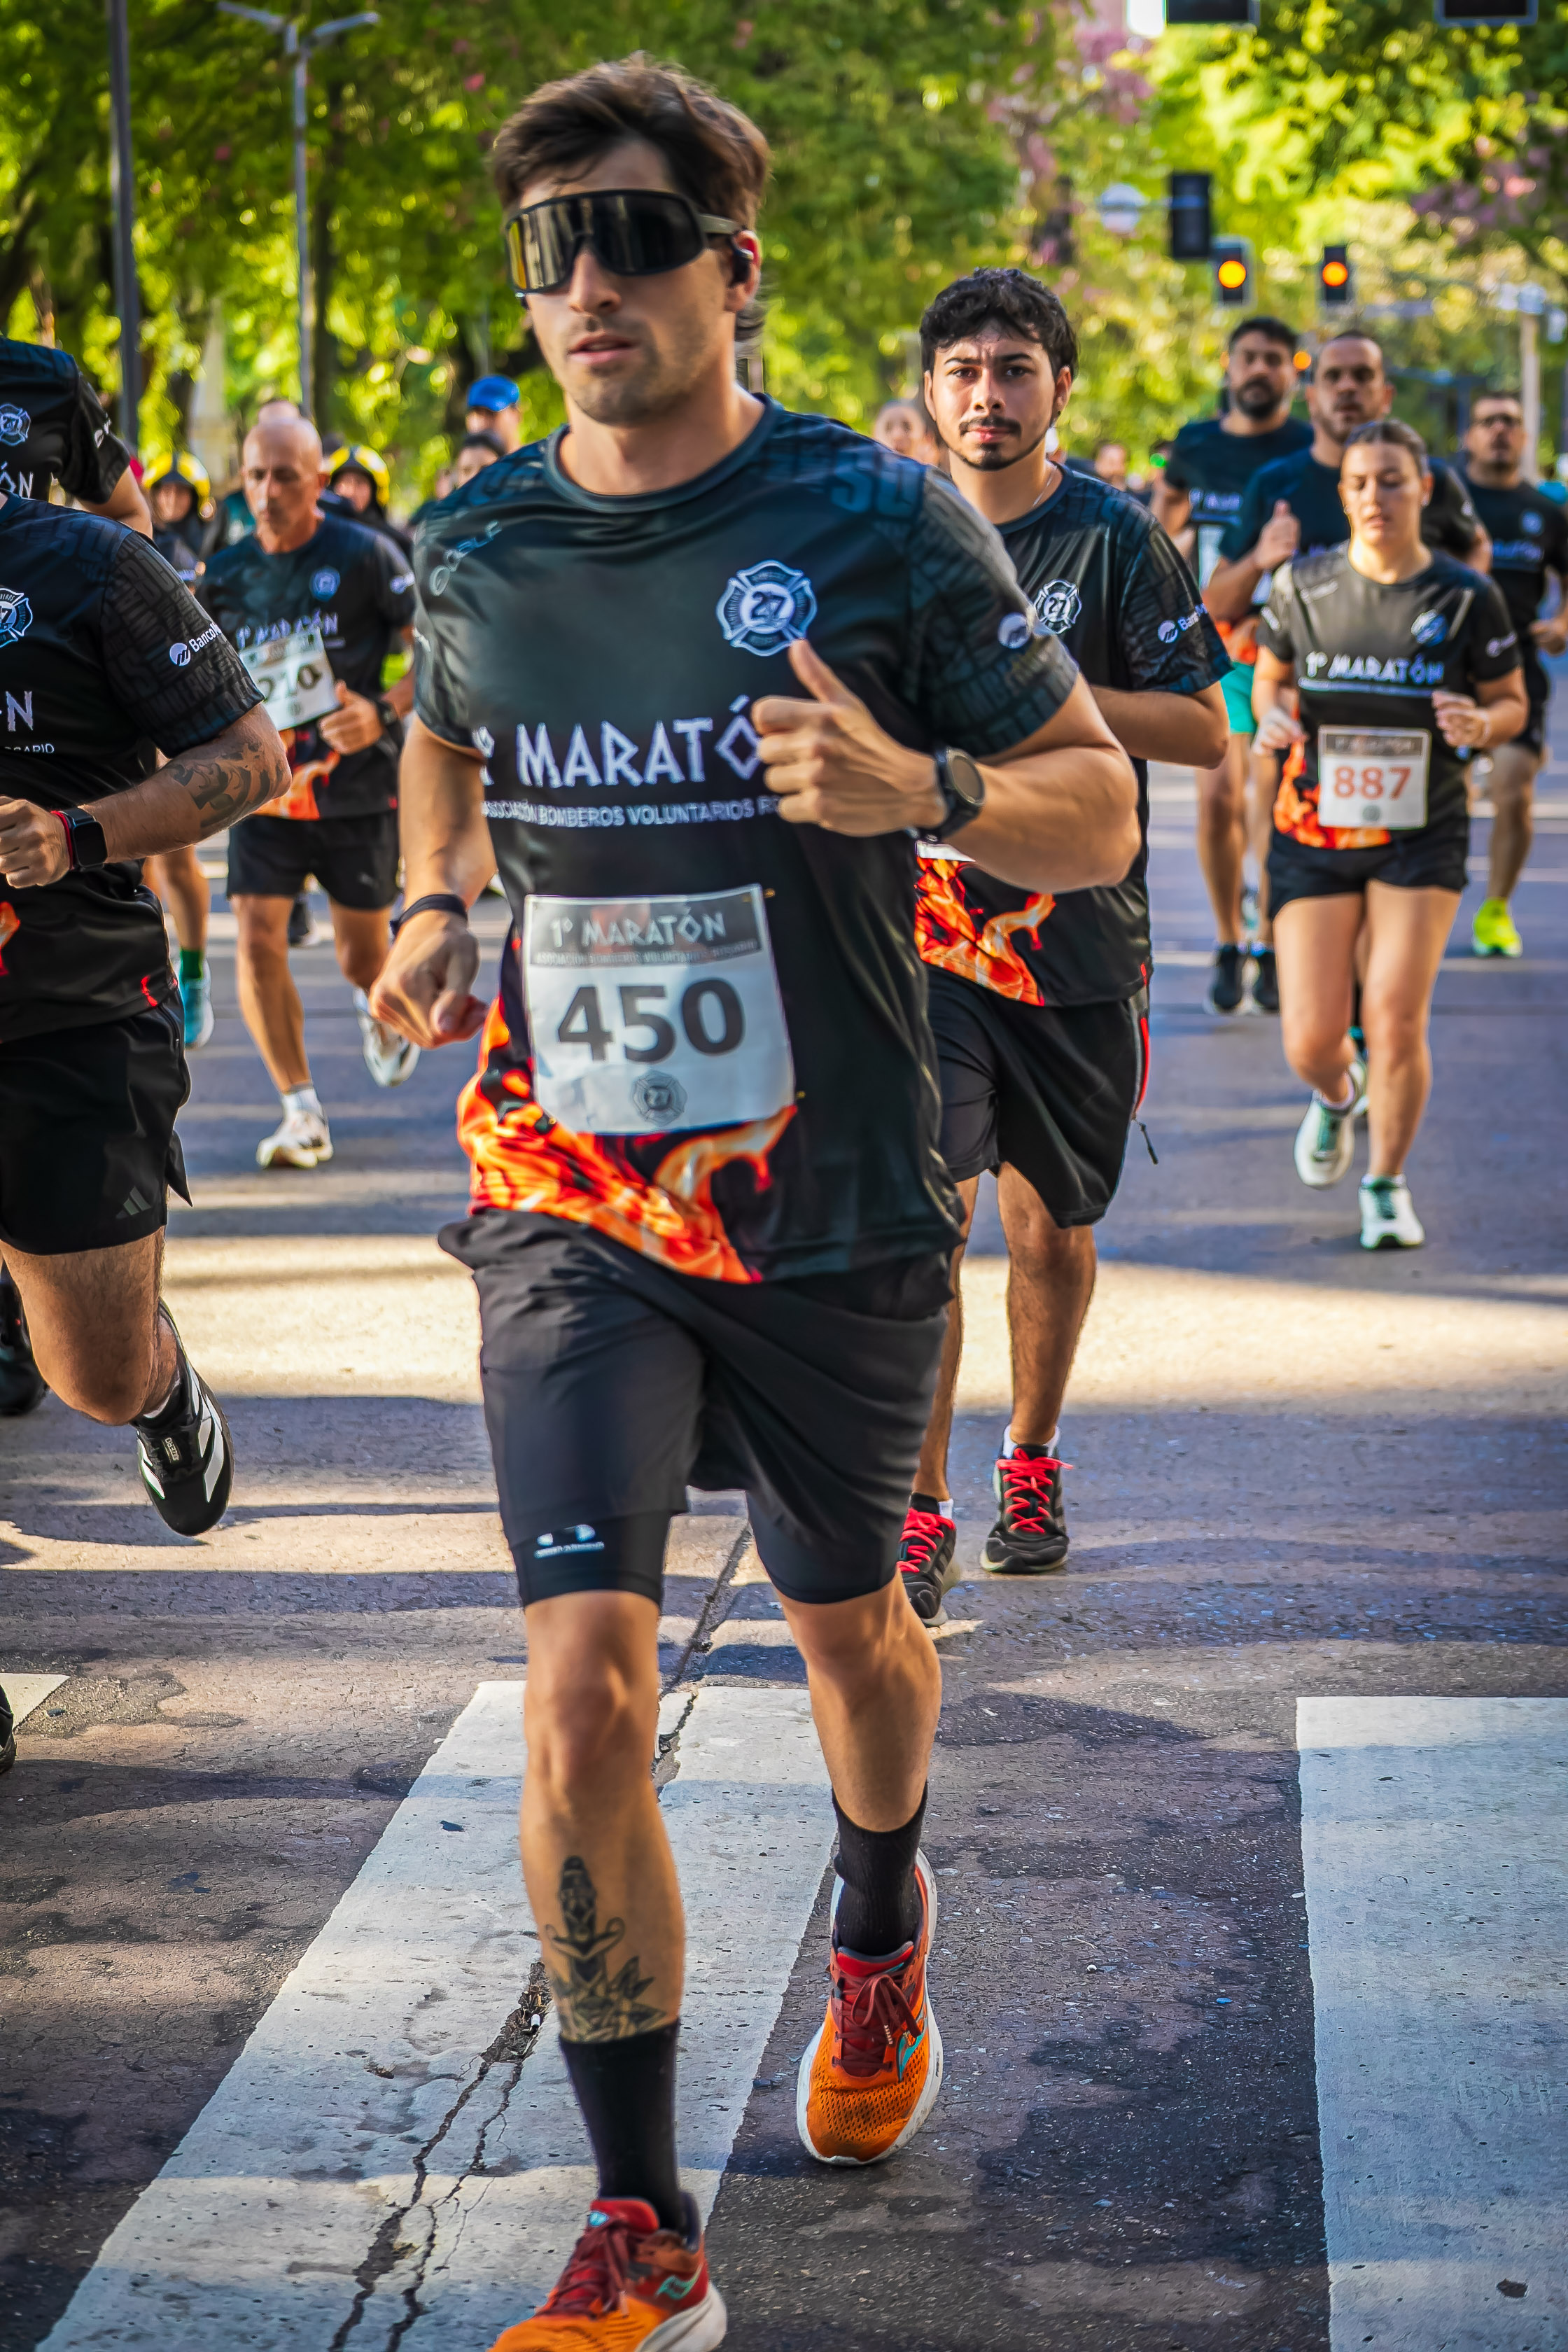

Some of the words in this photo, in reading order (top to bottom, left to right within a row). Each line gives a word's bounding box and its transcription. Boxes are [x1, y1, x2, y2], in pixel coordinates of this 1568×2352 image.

[0, 605, 13, 624] 7
[751, 591, 786, 620] 27
[1050, 597, 1067, 615] 27
[1334, 766, 1412, 801] 887
[538, 803, 625, 827] BOMBEROS
[626, 798, 755, 826] VOLUNTARIOS
[582, 906, 726, 946] MARATÓN
[557, 976, 746, 1065] 450
